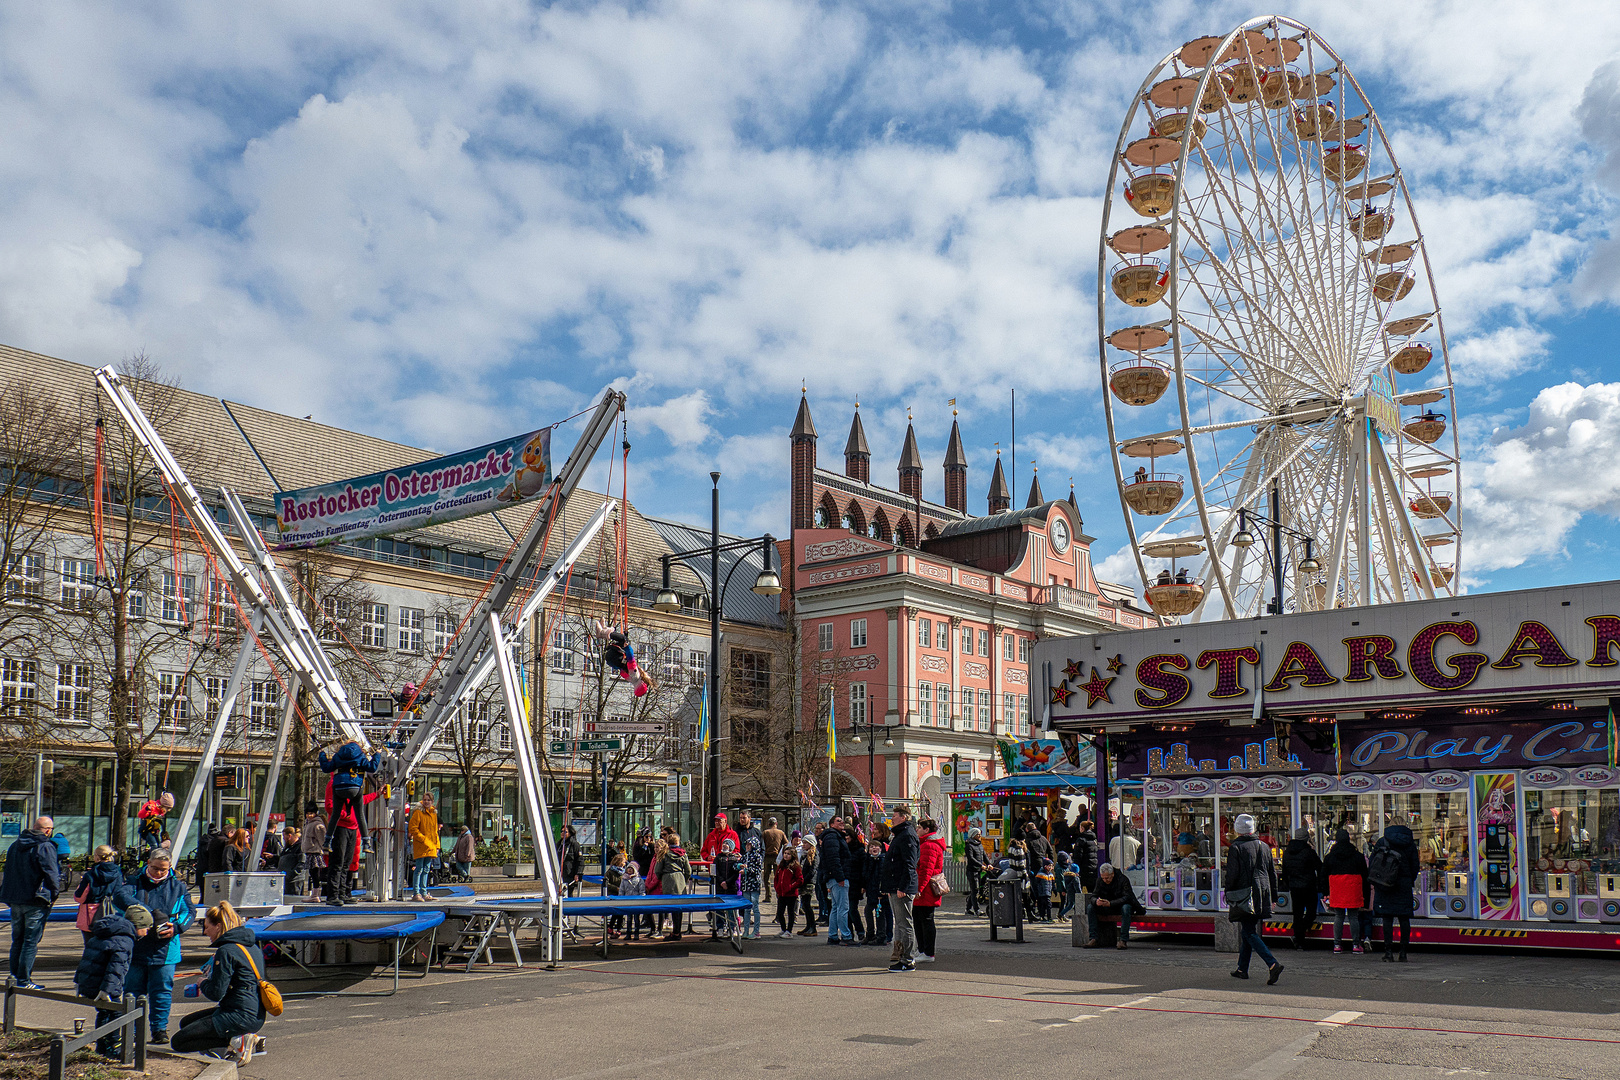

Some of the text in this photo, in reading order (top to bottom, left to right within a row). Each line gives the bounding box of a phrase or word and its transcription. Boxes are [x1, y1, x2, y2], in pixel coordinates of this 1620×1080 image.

[281, 447, 514, 523] Rostocker Ostermarkt
[282, 489, 493, 544] Mittwochs Familientag Ostermontag Gottesdienst
[1350, 730, 1513, 767] Play
